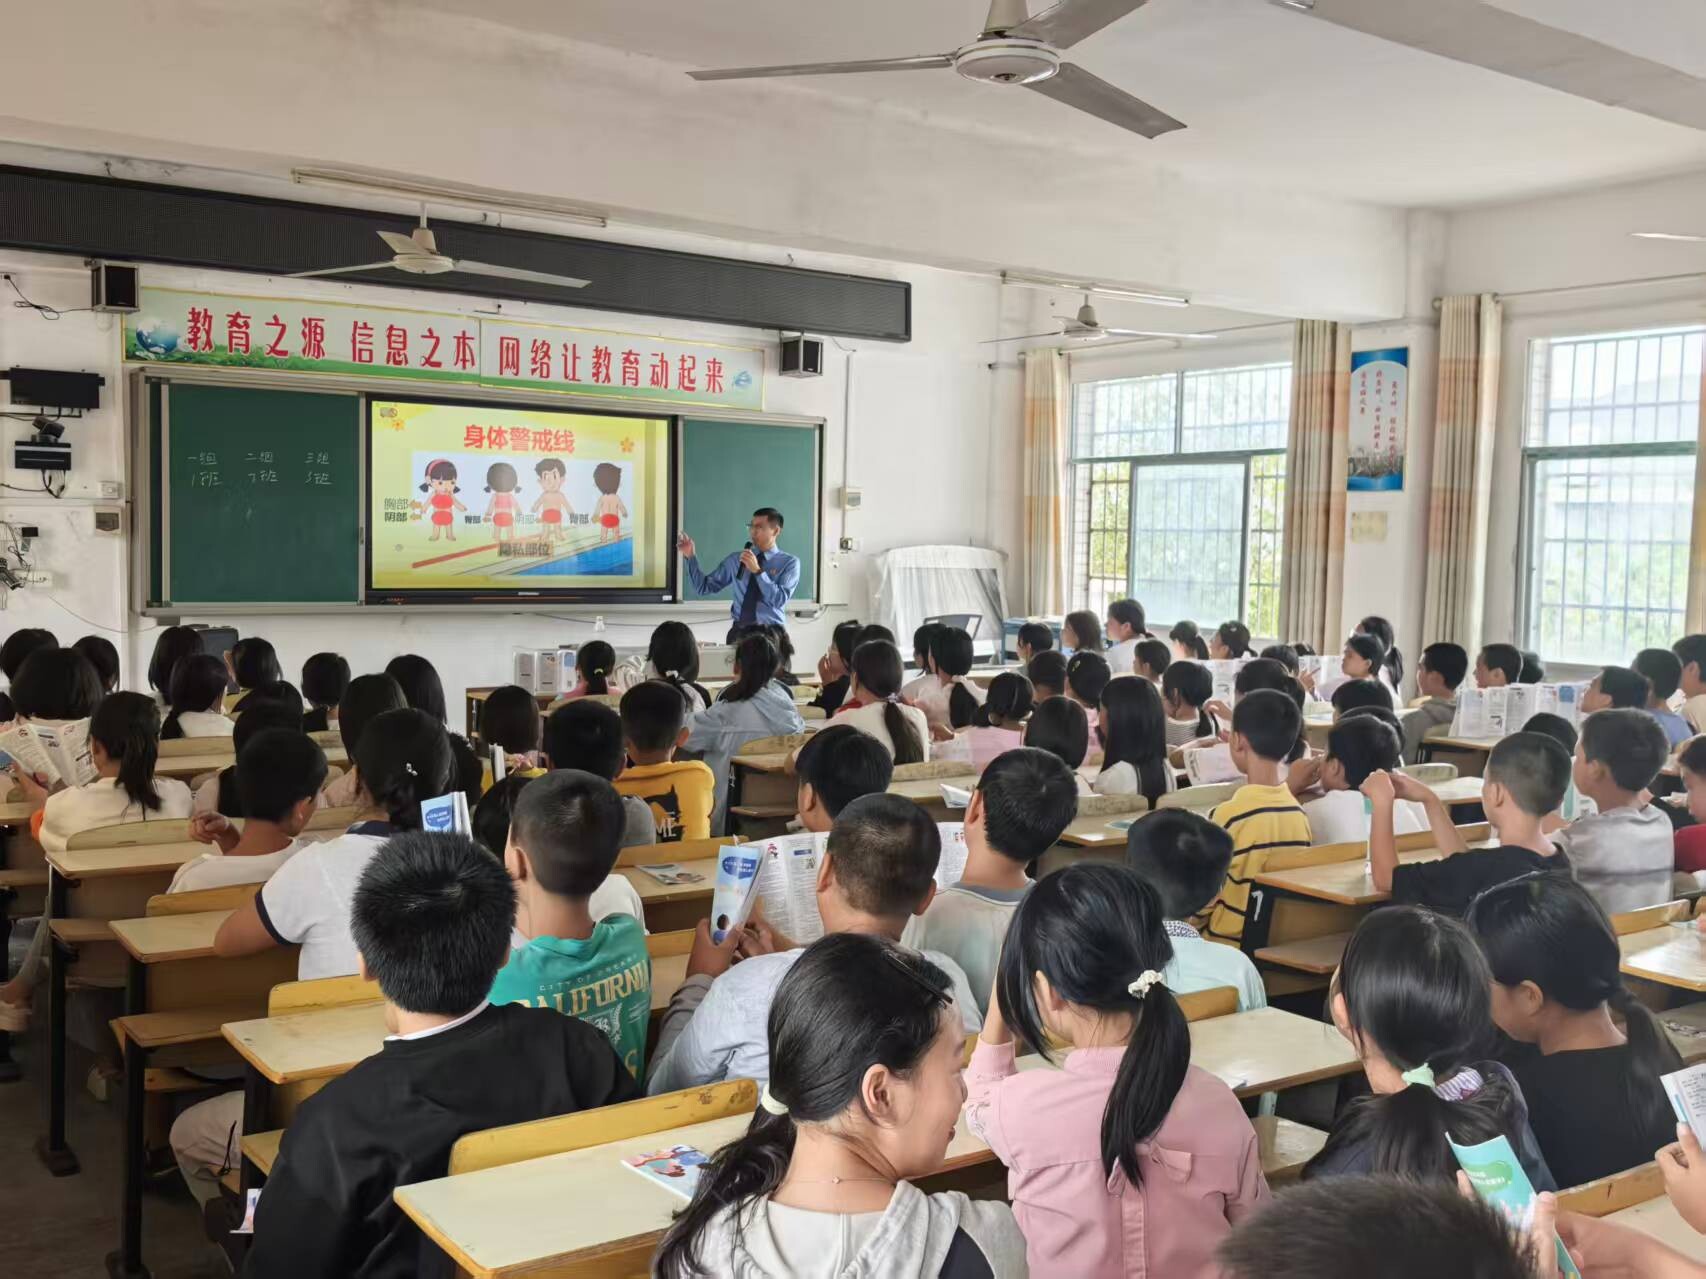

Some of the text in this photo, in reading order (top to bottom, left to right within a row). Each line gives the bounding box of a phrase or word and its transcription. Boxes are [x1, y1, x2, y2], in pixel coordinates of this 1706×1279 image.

[188, 308, 723, 394] 教育之源 信息之本 网络让教育动起来
[464, 425, 574, 453] 身体警戒线
[384, 497, 409, 510] 胸部
[384, 511, 408, 523] 阴部
